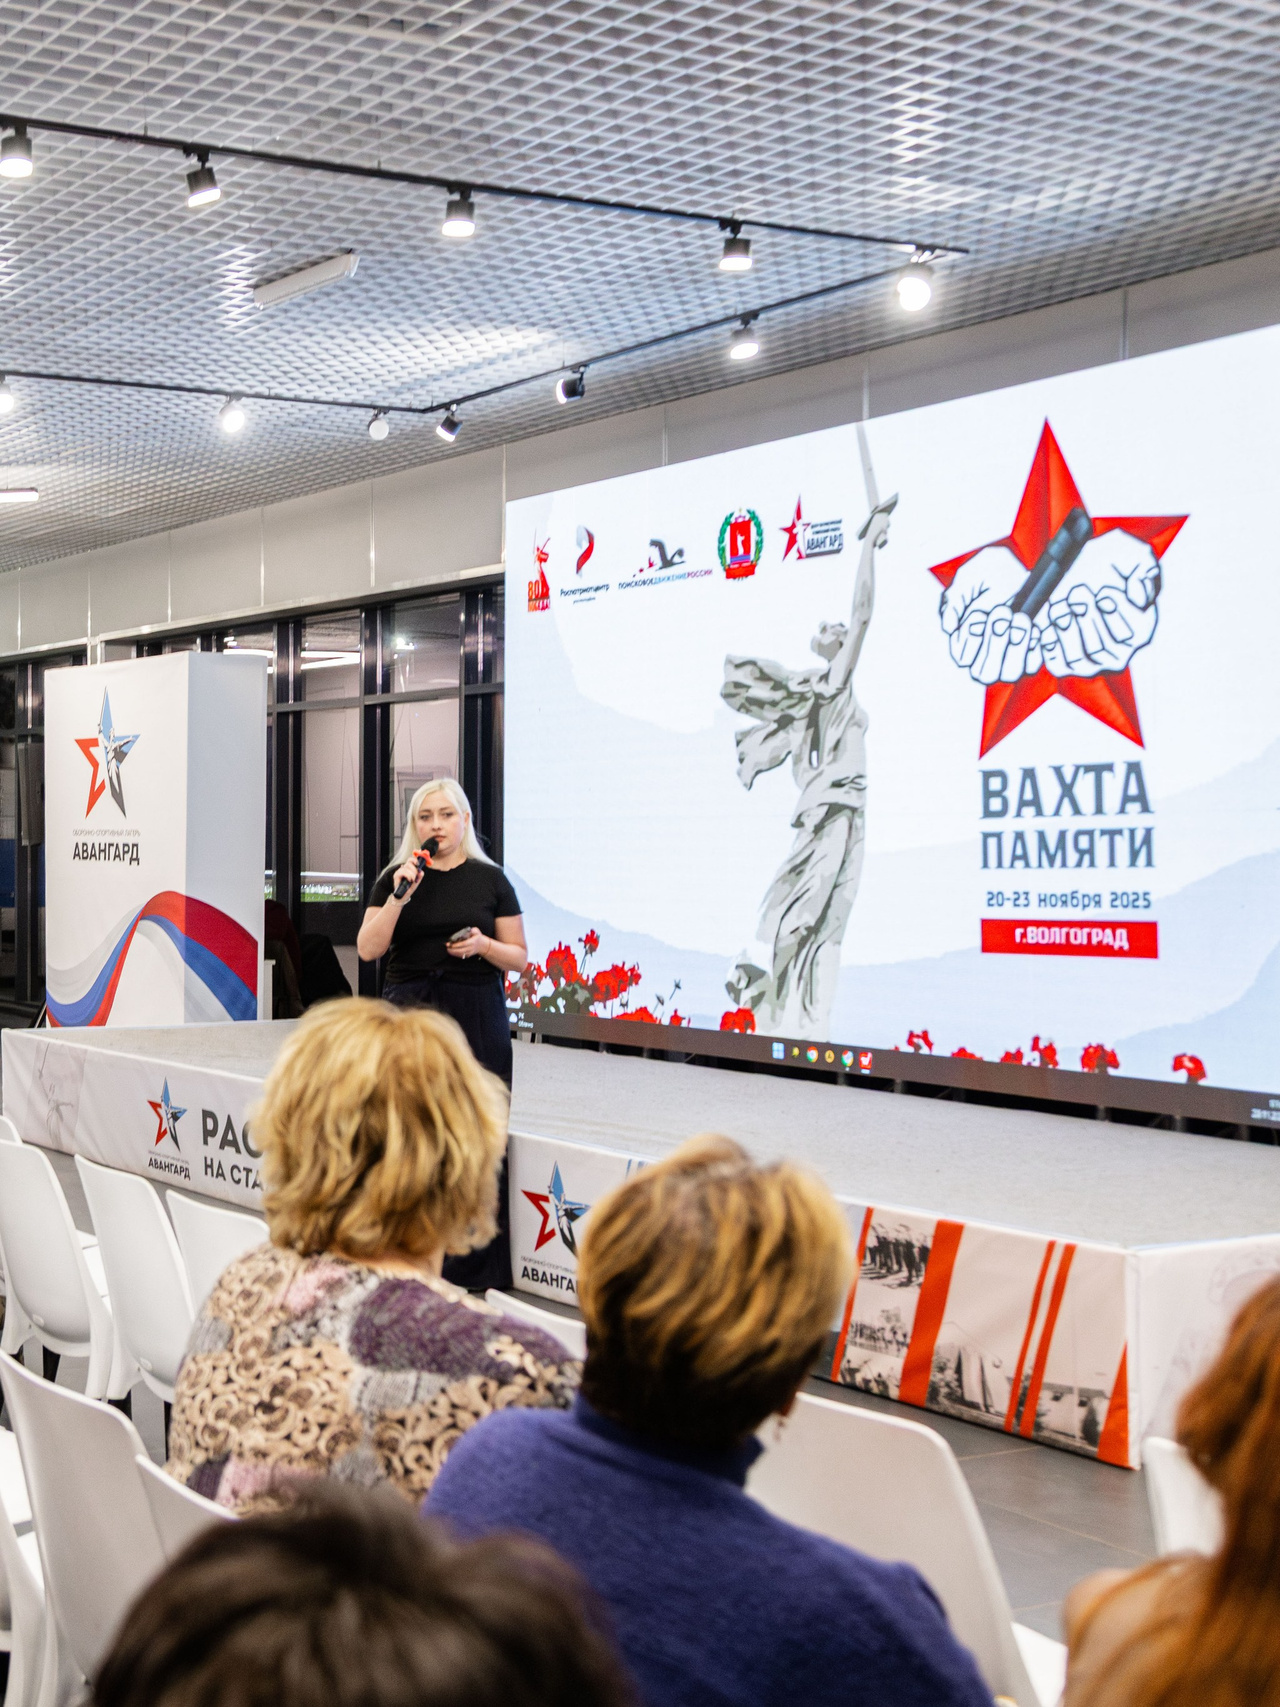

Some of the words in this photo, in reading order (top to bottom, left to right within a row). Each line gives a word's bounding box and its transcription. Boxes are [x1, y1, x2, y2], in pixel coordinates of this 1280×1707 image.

[978, 761, 1155, 820] ВАХТА
[72, 841, 140, 866] АВАНГАРД
[980, 827, 1156, 870] ПАМЯТИ
[987, 891, 1031, 908] 20-23
[1038, 890, 1102, 910] ноября
[1110, 891, 1152, 909] 2025
[1014, 926, 1130, 951] г.ВОЛГОГРАД
[148, 1157, 191, 1181] АВАНГАРД
[204, 1156, 227, 1181] НА
[521, 1265, 578, 1293] АВАНГА
